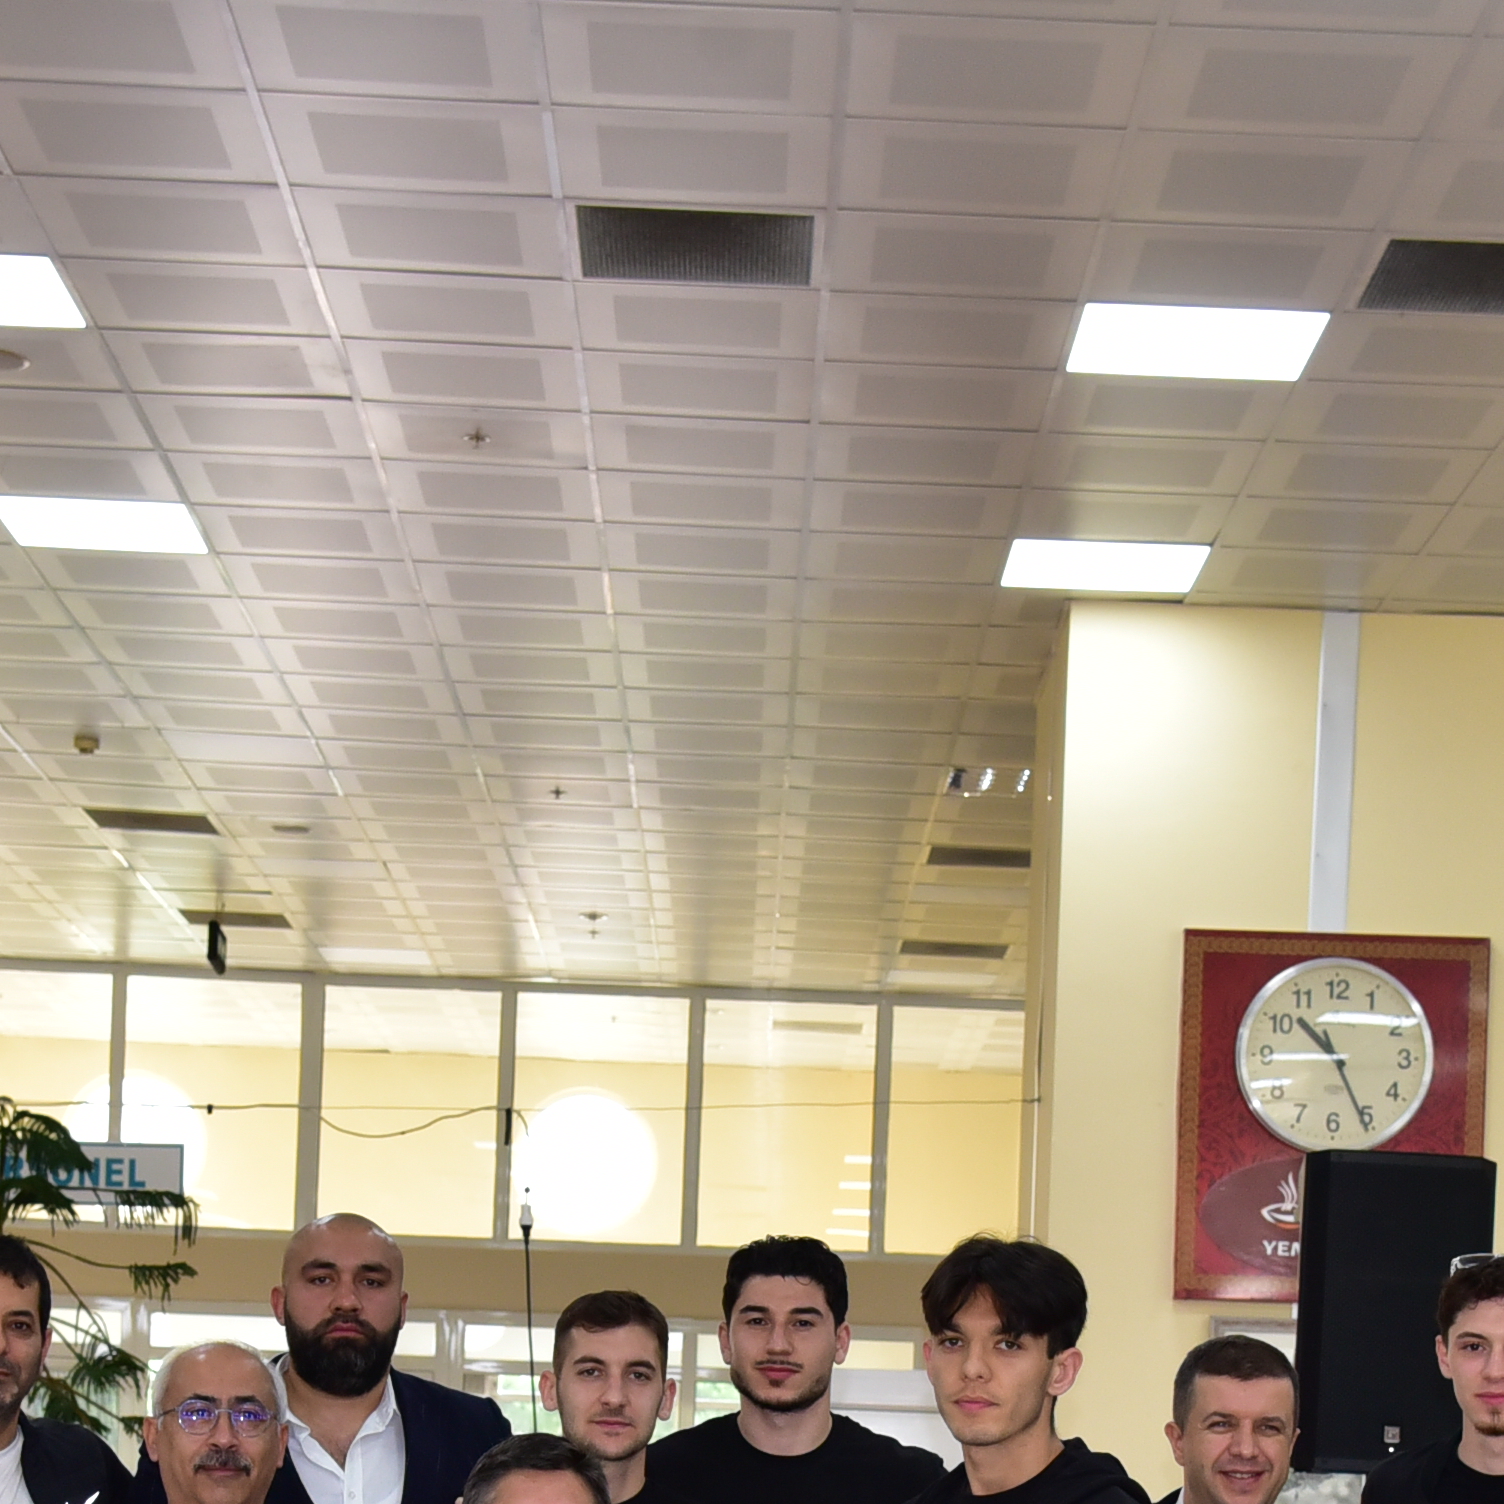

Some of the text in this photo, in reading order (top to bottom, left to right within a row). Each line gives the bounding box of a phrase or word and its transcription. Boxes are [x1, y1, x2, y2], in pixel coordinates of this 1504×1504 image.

[1291, 988, 1312, 1009] 11
[1324, 979, 1350, 1000] 12
[1365, 990, 1375, 1011] 1
[1268, 1013, 1293, 1035] 10
[1259, 1045, 1274, 1066] 9
[1397, 1049, 1412, 1070] 3
[1270, 1078, 1285, 1100] 8
[1385, 1081, 1400, 1102] 4
[1294, 1103, 1308, 1124] 7
[1326, 1112, 1341, 1133] 6
[1360, 1105, 1374, 1127] 5
